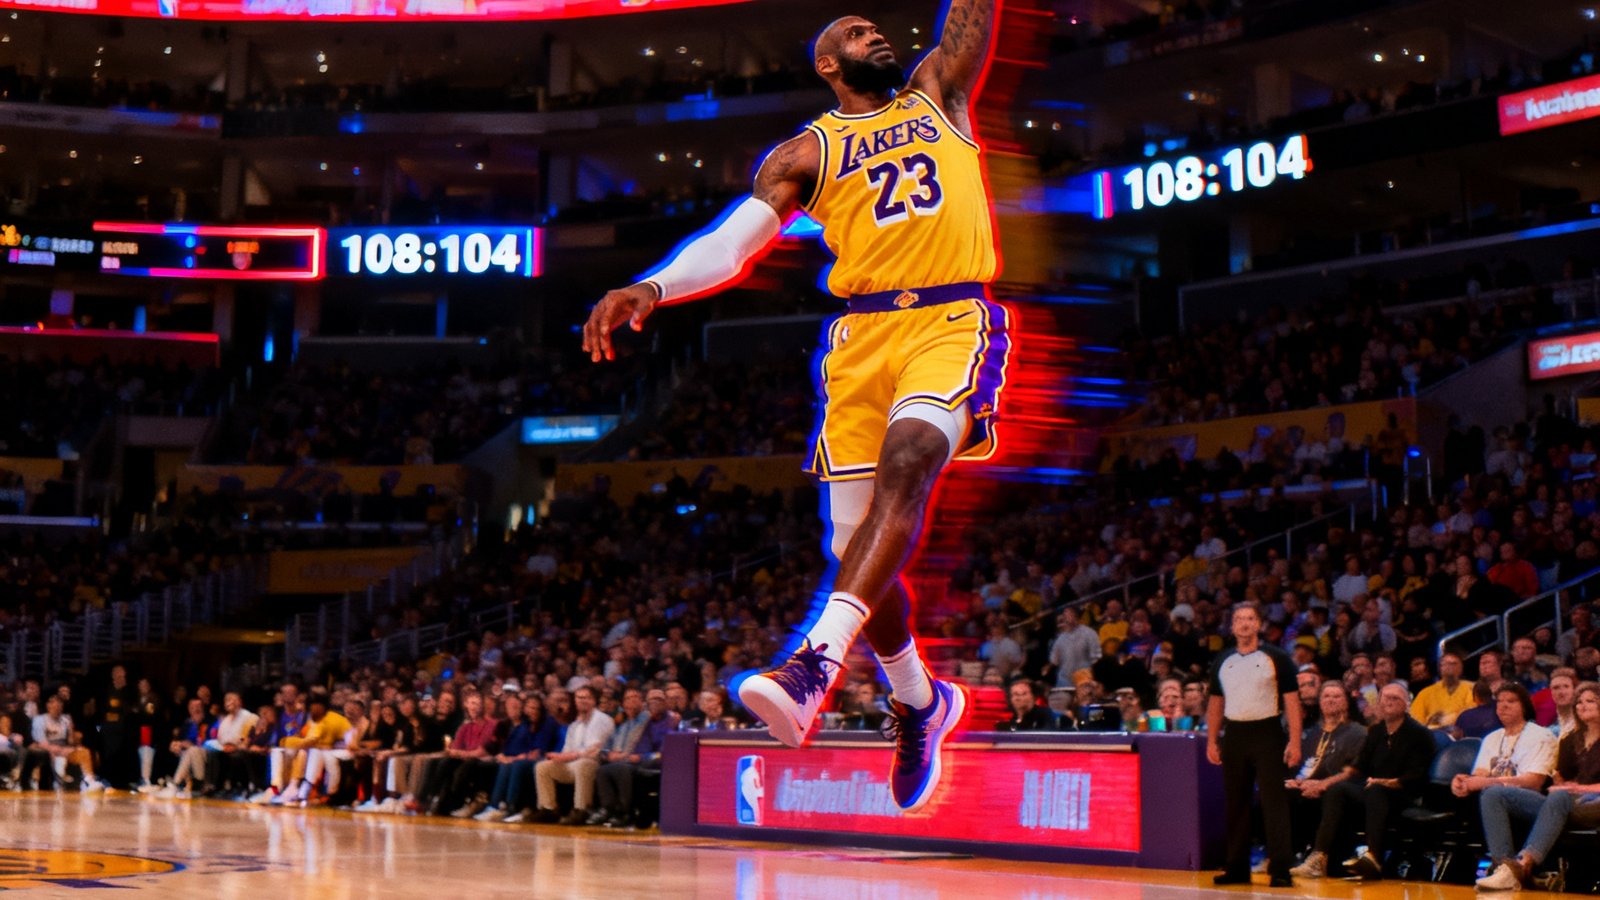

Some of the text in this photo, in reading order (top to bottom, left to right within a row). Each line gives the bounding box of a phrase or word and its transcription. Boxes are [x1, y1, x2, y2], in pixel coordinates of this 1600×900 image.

[836, 115, 941, 180] LAKERS
[1123, 134, 1313, 210] 108:104
[865, 152, 943, 228] 23
[340, 232, 521, 275] 108:104
